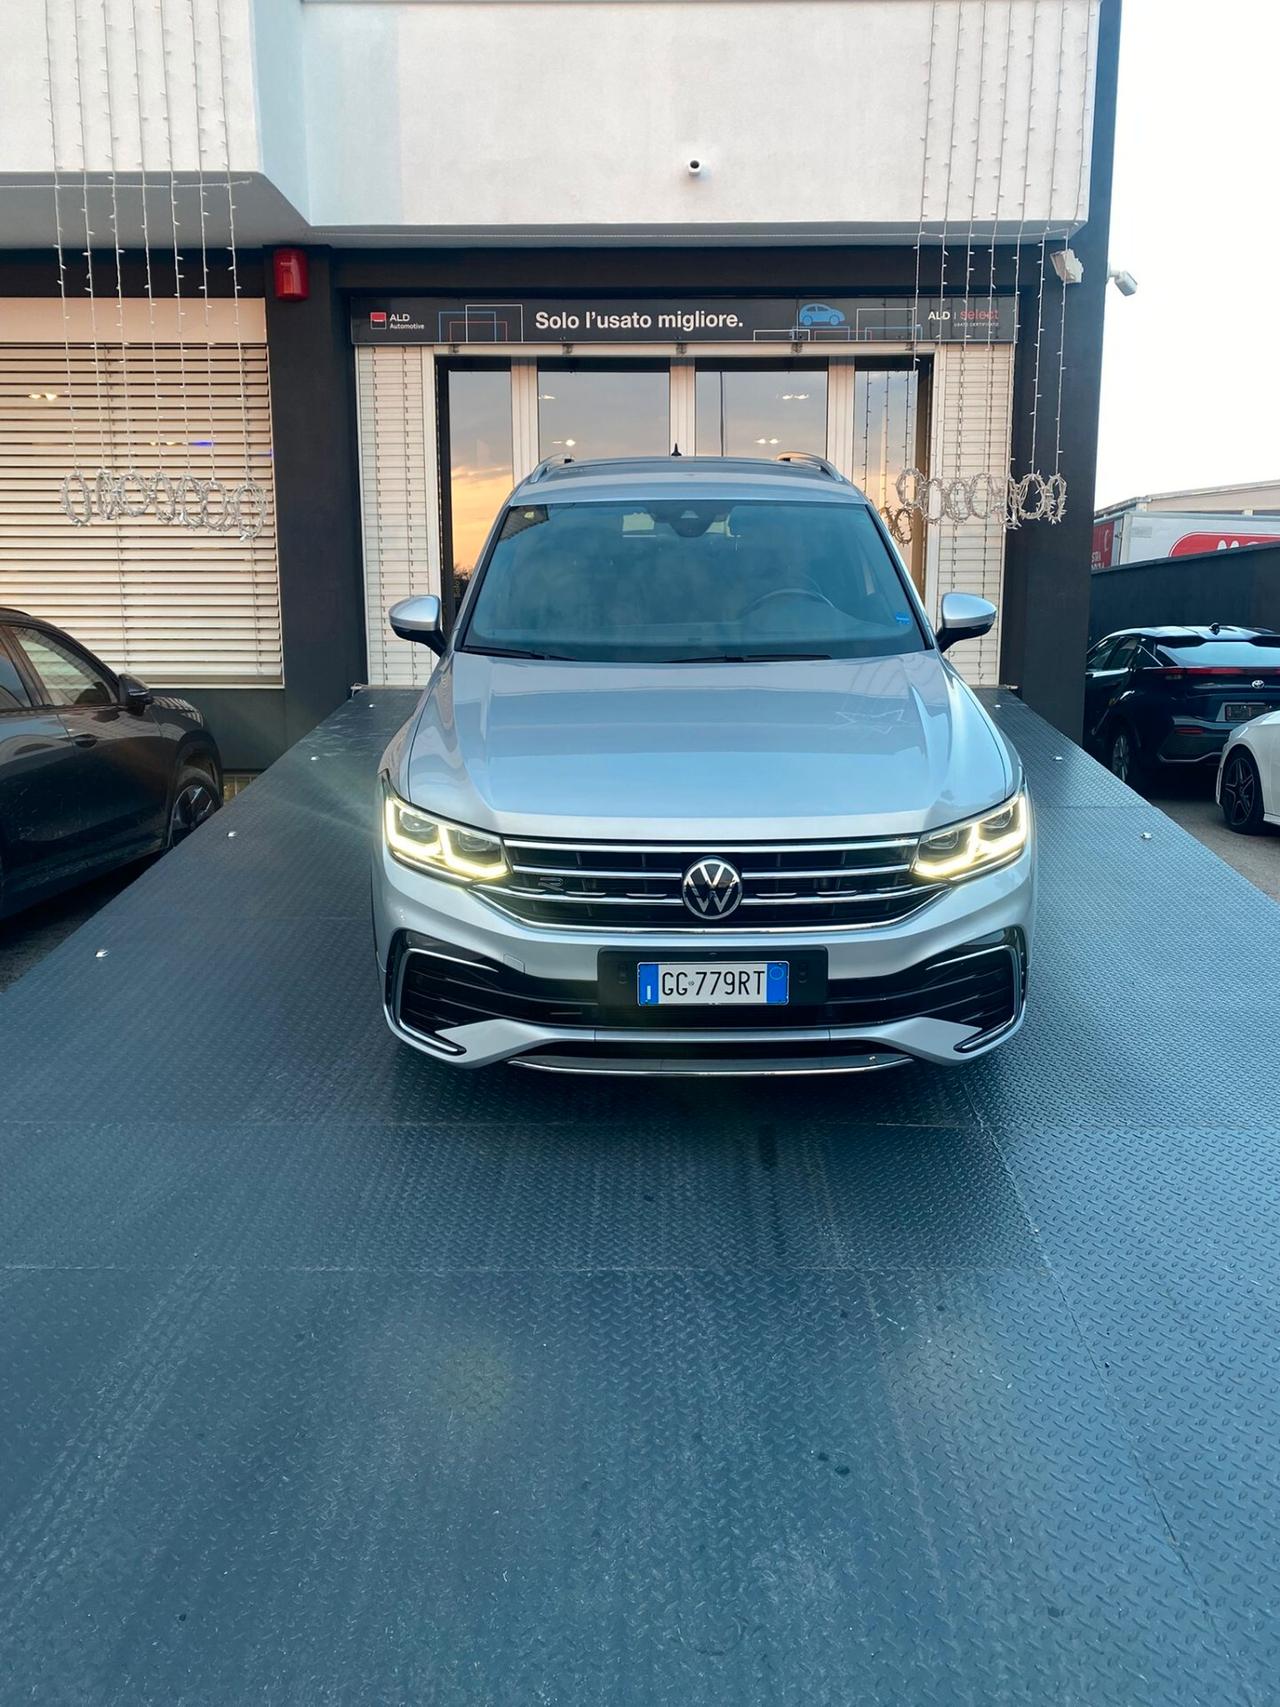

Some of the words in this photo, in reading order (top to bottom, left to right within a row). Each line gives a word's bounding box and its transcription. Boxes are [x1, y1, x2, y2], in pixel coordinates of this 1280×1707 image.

[390, 313, 410, 321] ALD
[928, 311, 951, 320] ALD
[960, 308, 999, 320] select
[535, 311, 580, 329] Solo
[658, 310, 744, 332] migliore.
